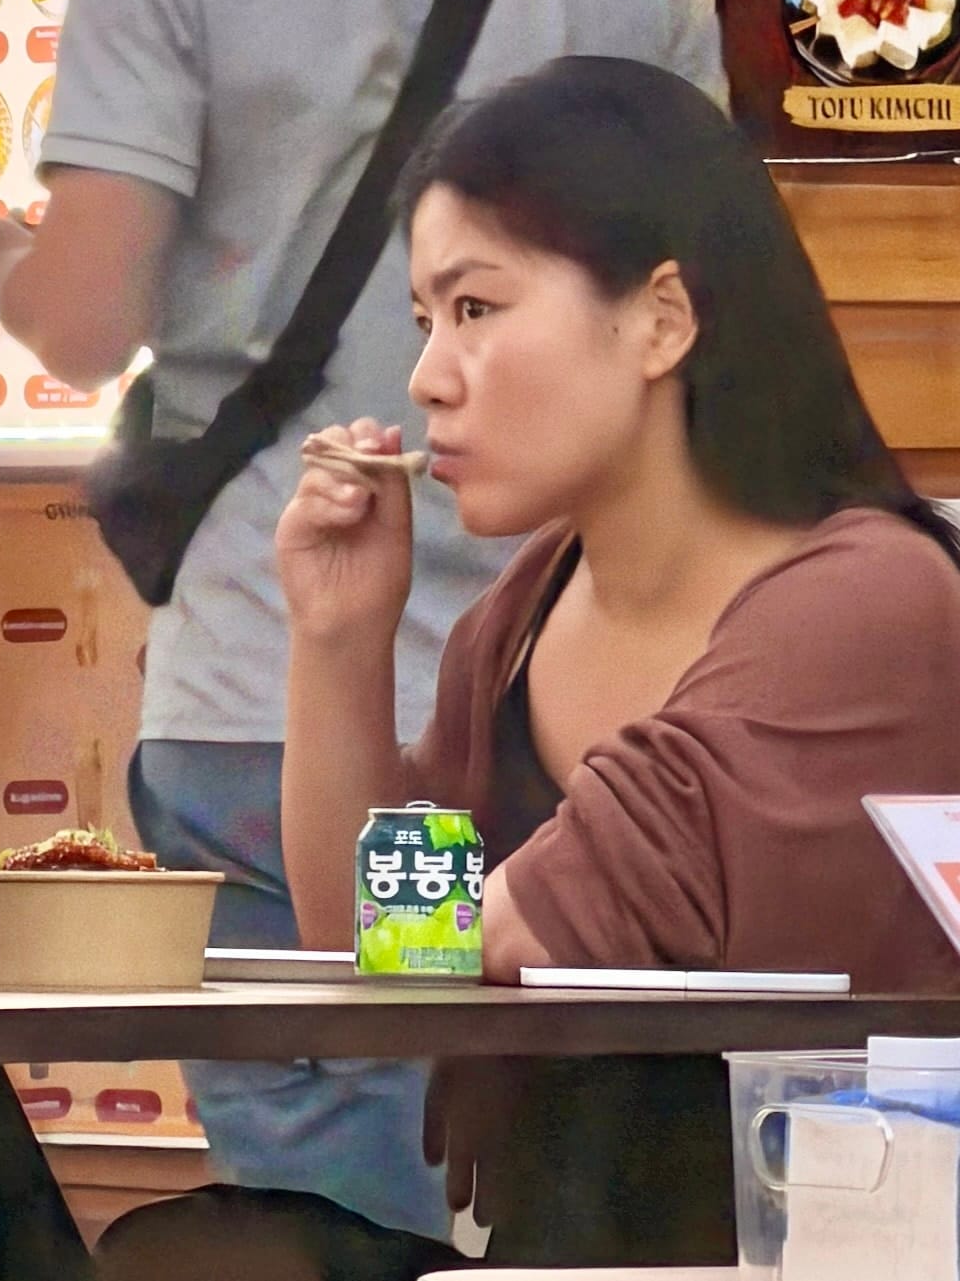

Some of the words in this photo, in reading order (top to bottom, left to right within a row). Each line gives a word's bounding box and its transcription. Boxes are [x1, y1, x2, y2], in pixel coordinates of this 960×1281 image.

[807, 95, 864, 121] TOFU
[870, 96, 952, 122] KIMCHI
[394, 830, 423, 846] 포도
